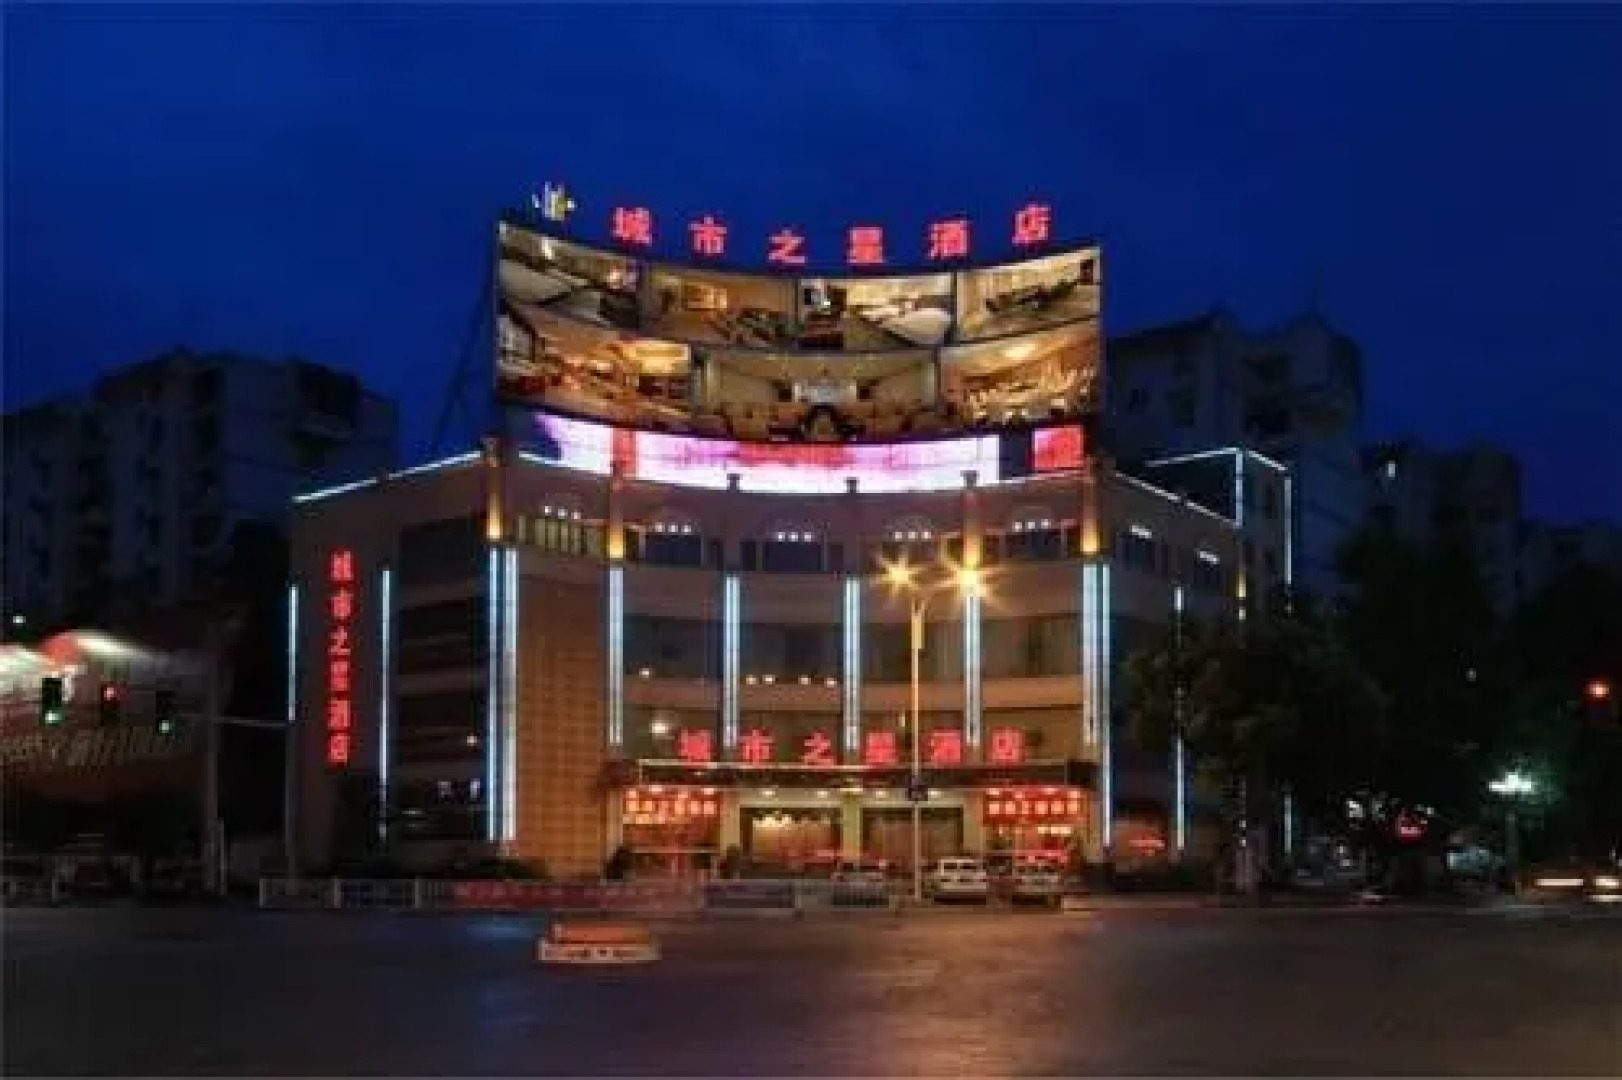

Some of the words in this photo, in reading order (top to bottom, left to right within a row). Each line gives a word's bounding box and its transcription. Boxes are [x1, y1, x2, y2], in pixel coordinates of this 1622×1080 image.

[612, 204, 1052, 265] 城市之星酒店
